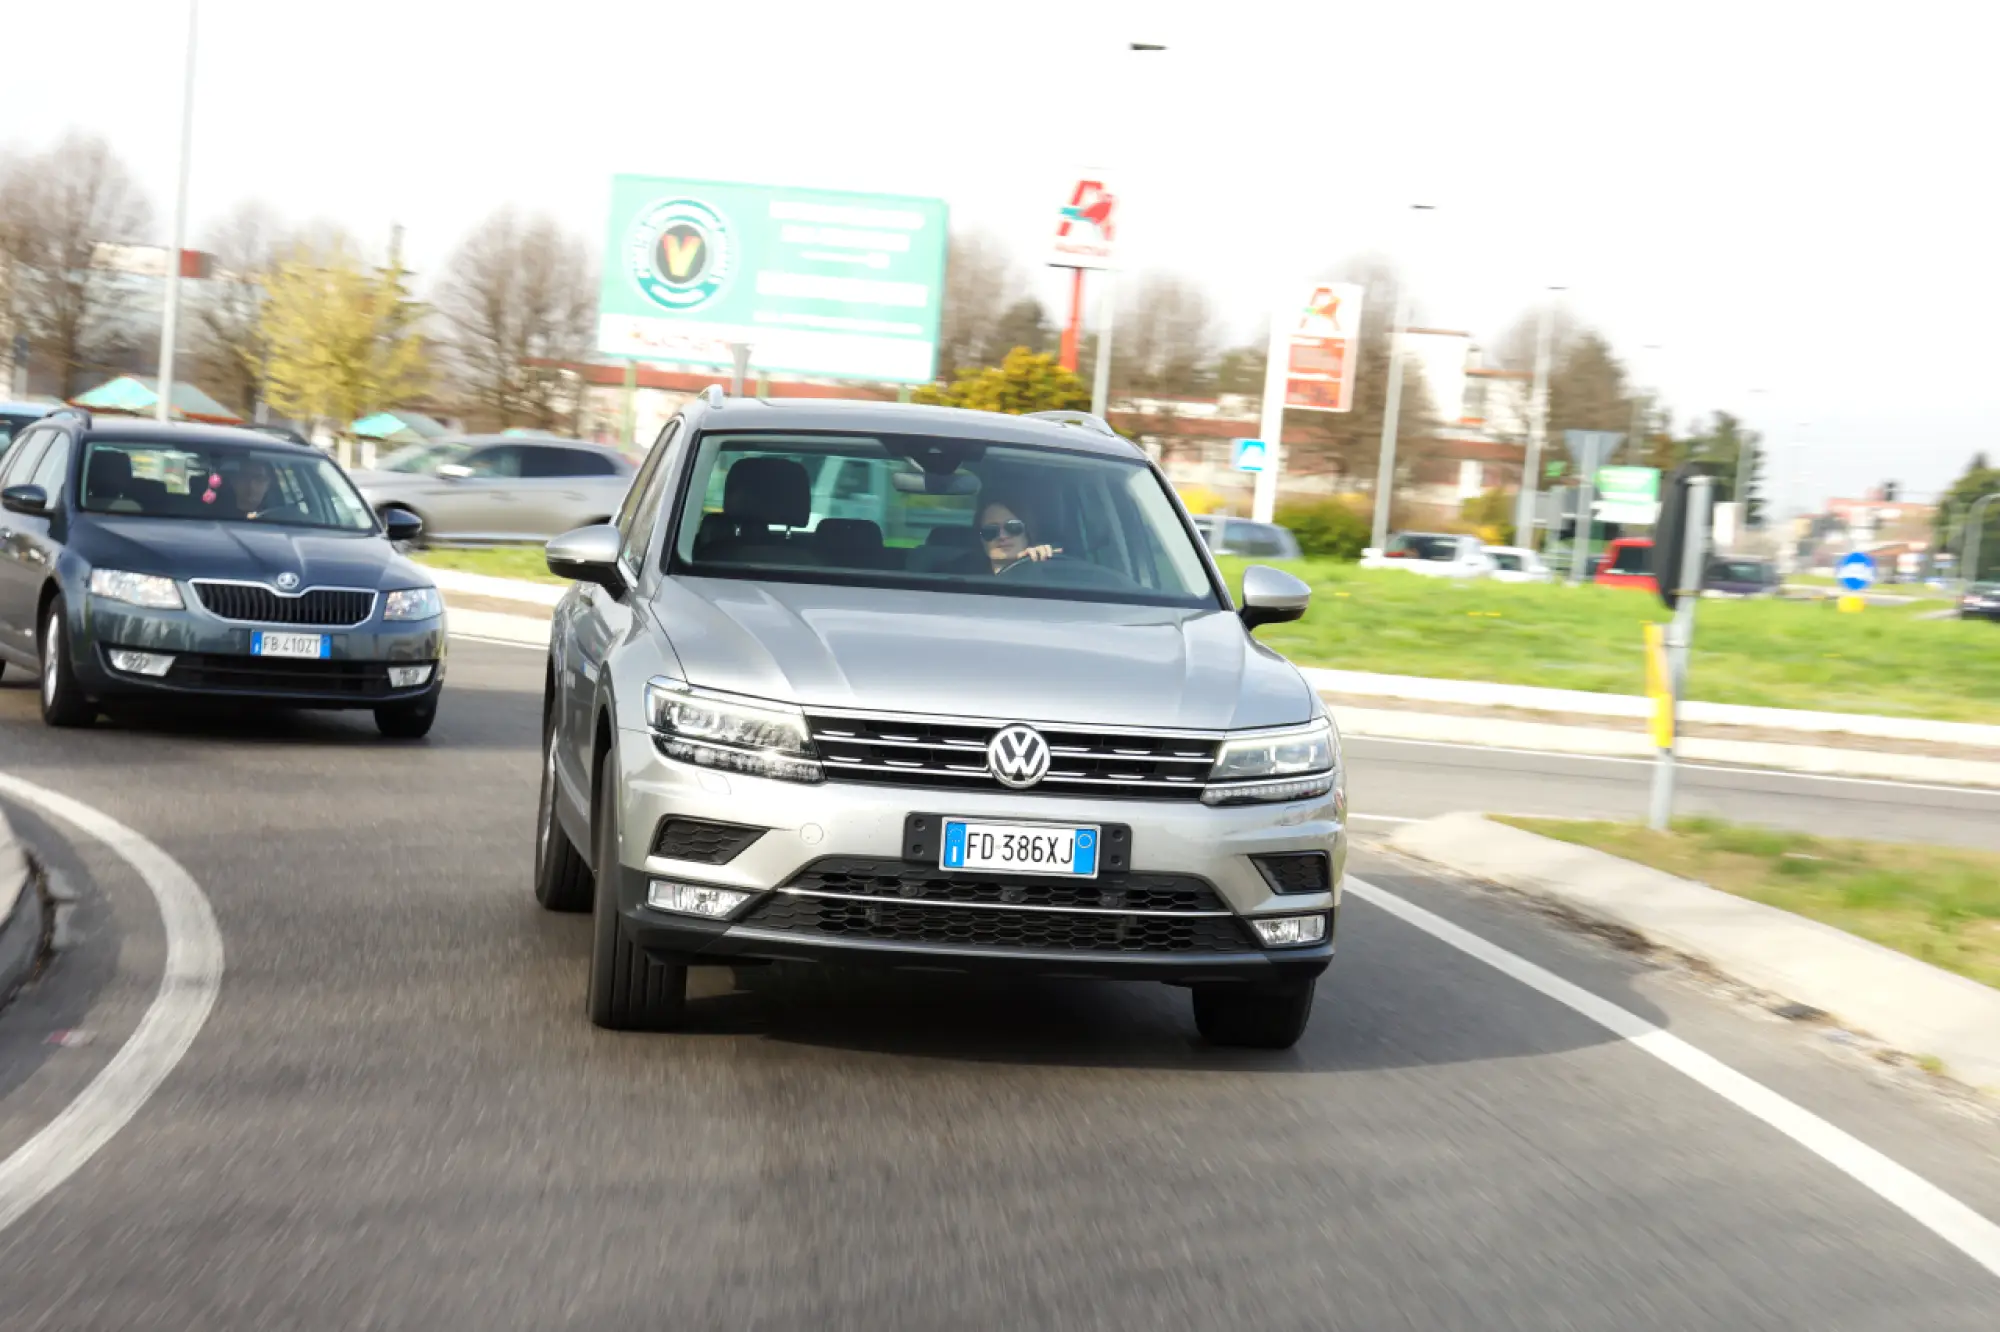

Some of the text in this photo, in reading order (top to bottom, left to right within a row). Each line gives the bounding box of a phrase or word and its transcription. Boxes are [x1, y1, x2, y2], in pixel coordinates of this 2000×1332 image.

[263, 635, 279, 651] FB
[966, 832, 994, 860] FD
[1002, 834, 1073, 864] 386XJ
